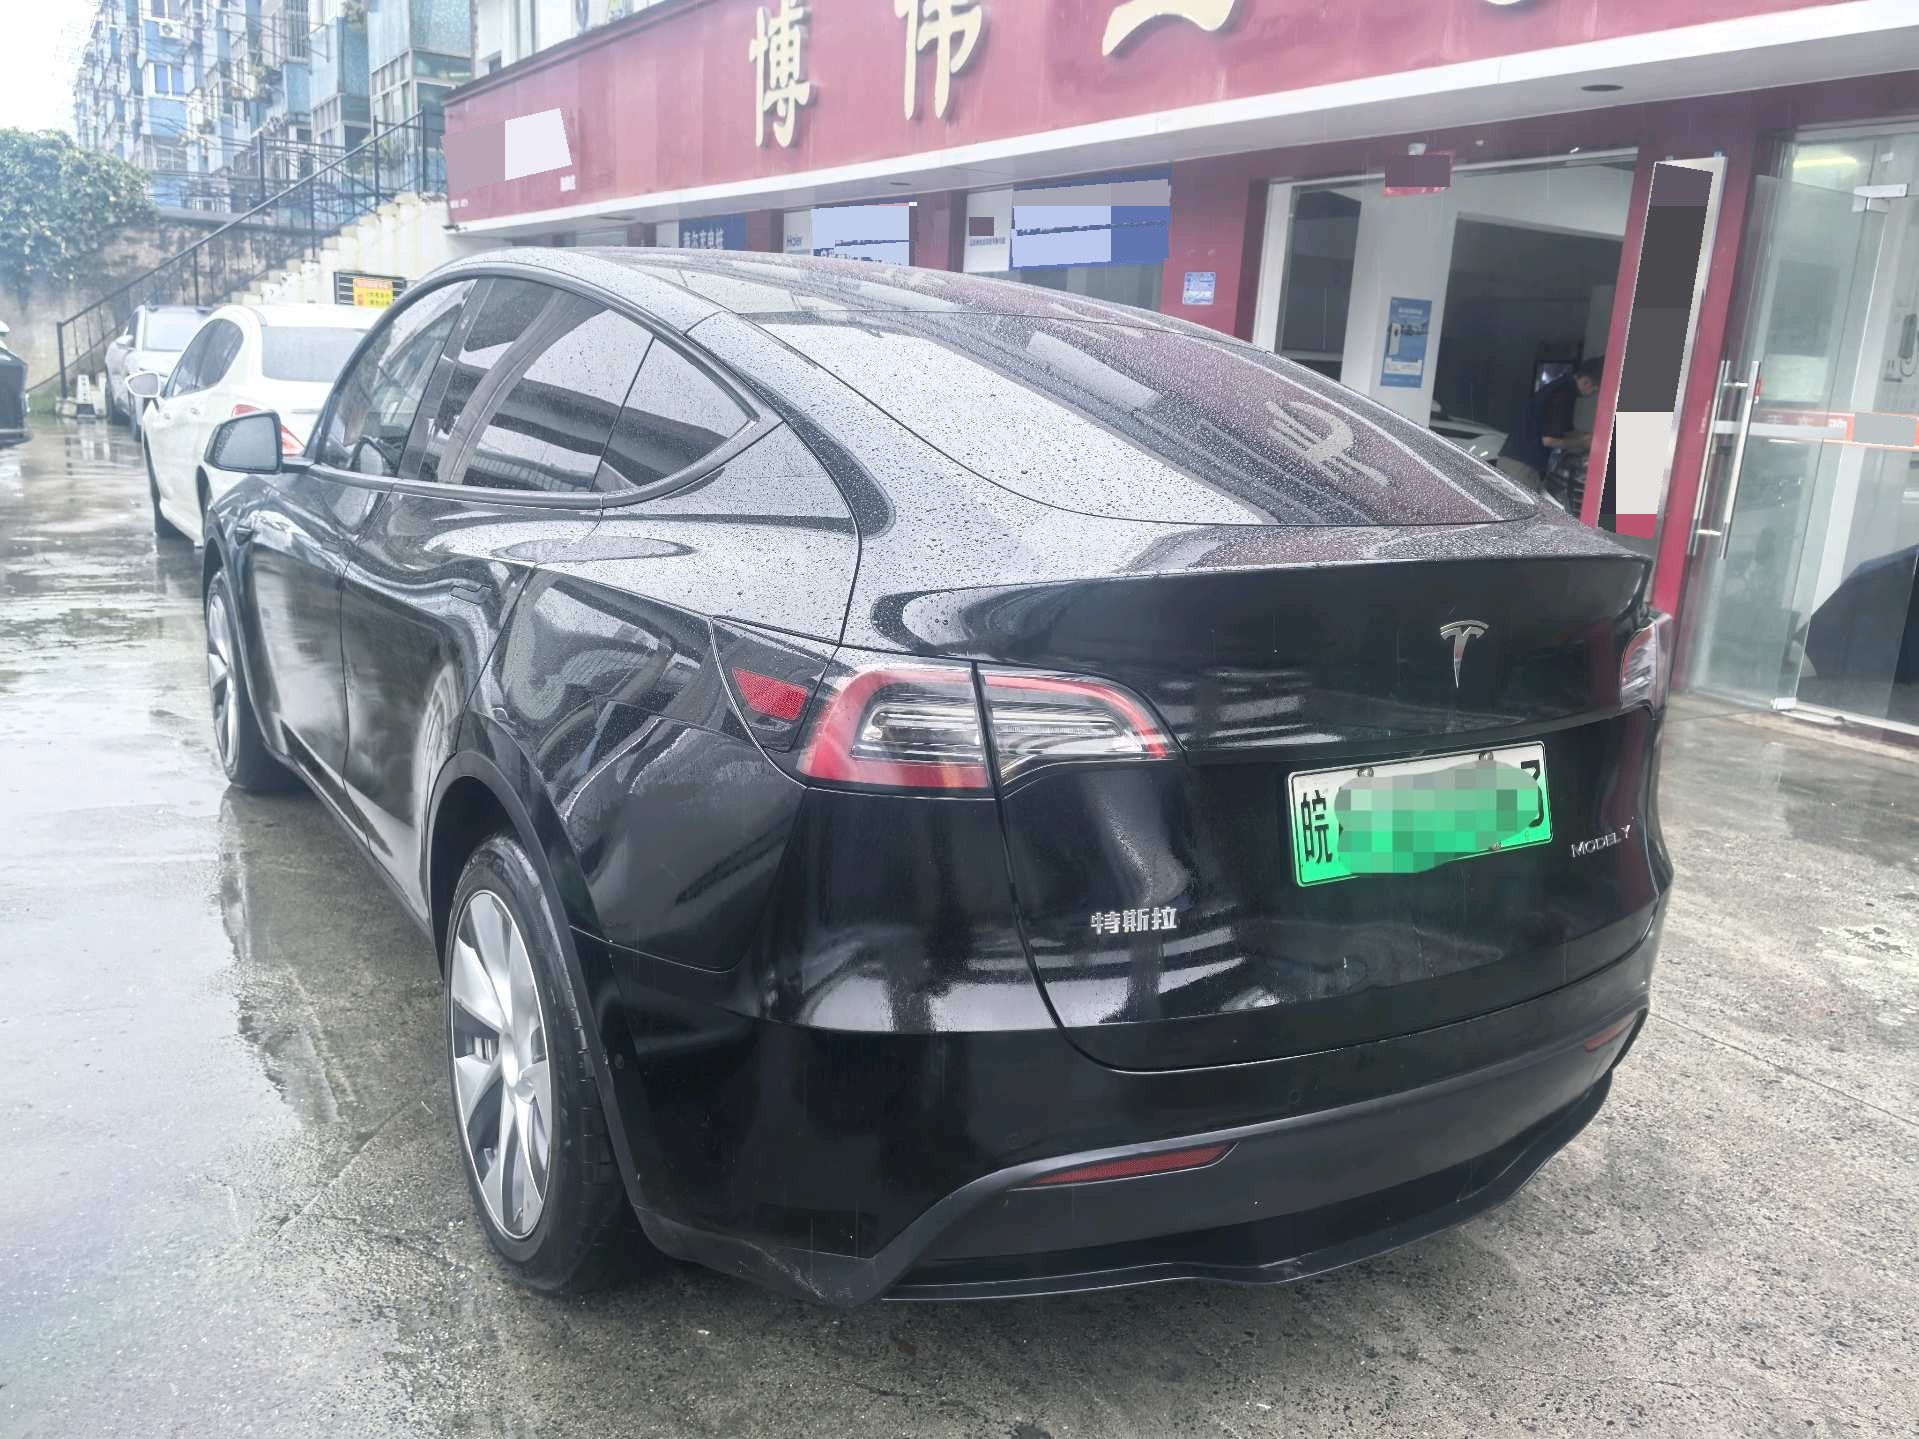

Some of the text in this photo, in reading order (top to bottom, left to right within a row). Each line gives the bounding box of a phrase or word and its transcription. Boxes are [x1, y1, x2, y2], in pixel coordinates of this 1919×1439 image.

[1301, 789, 1332, 865] 皖
[1571, 824, 1631, 858] MODEL Y
[1090, 906, 1178, 935] 特斯拉
